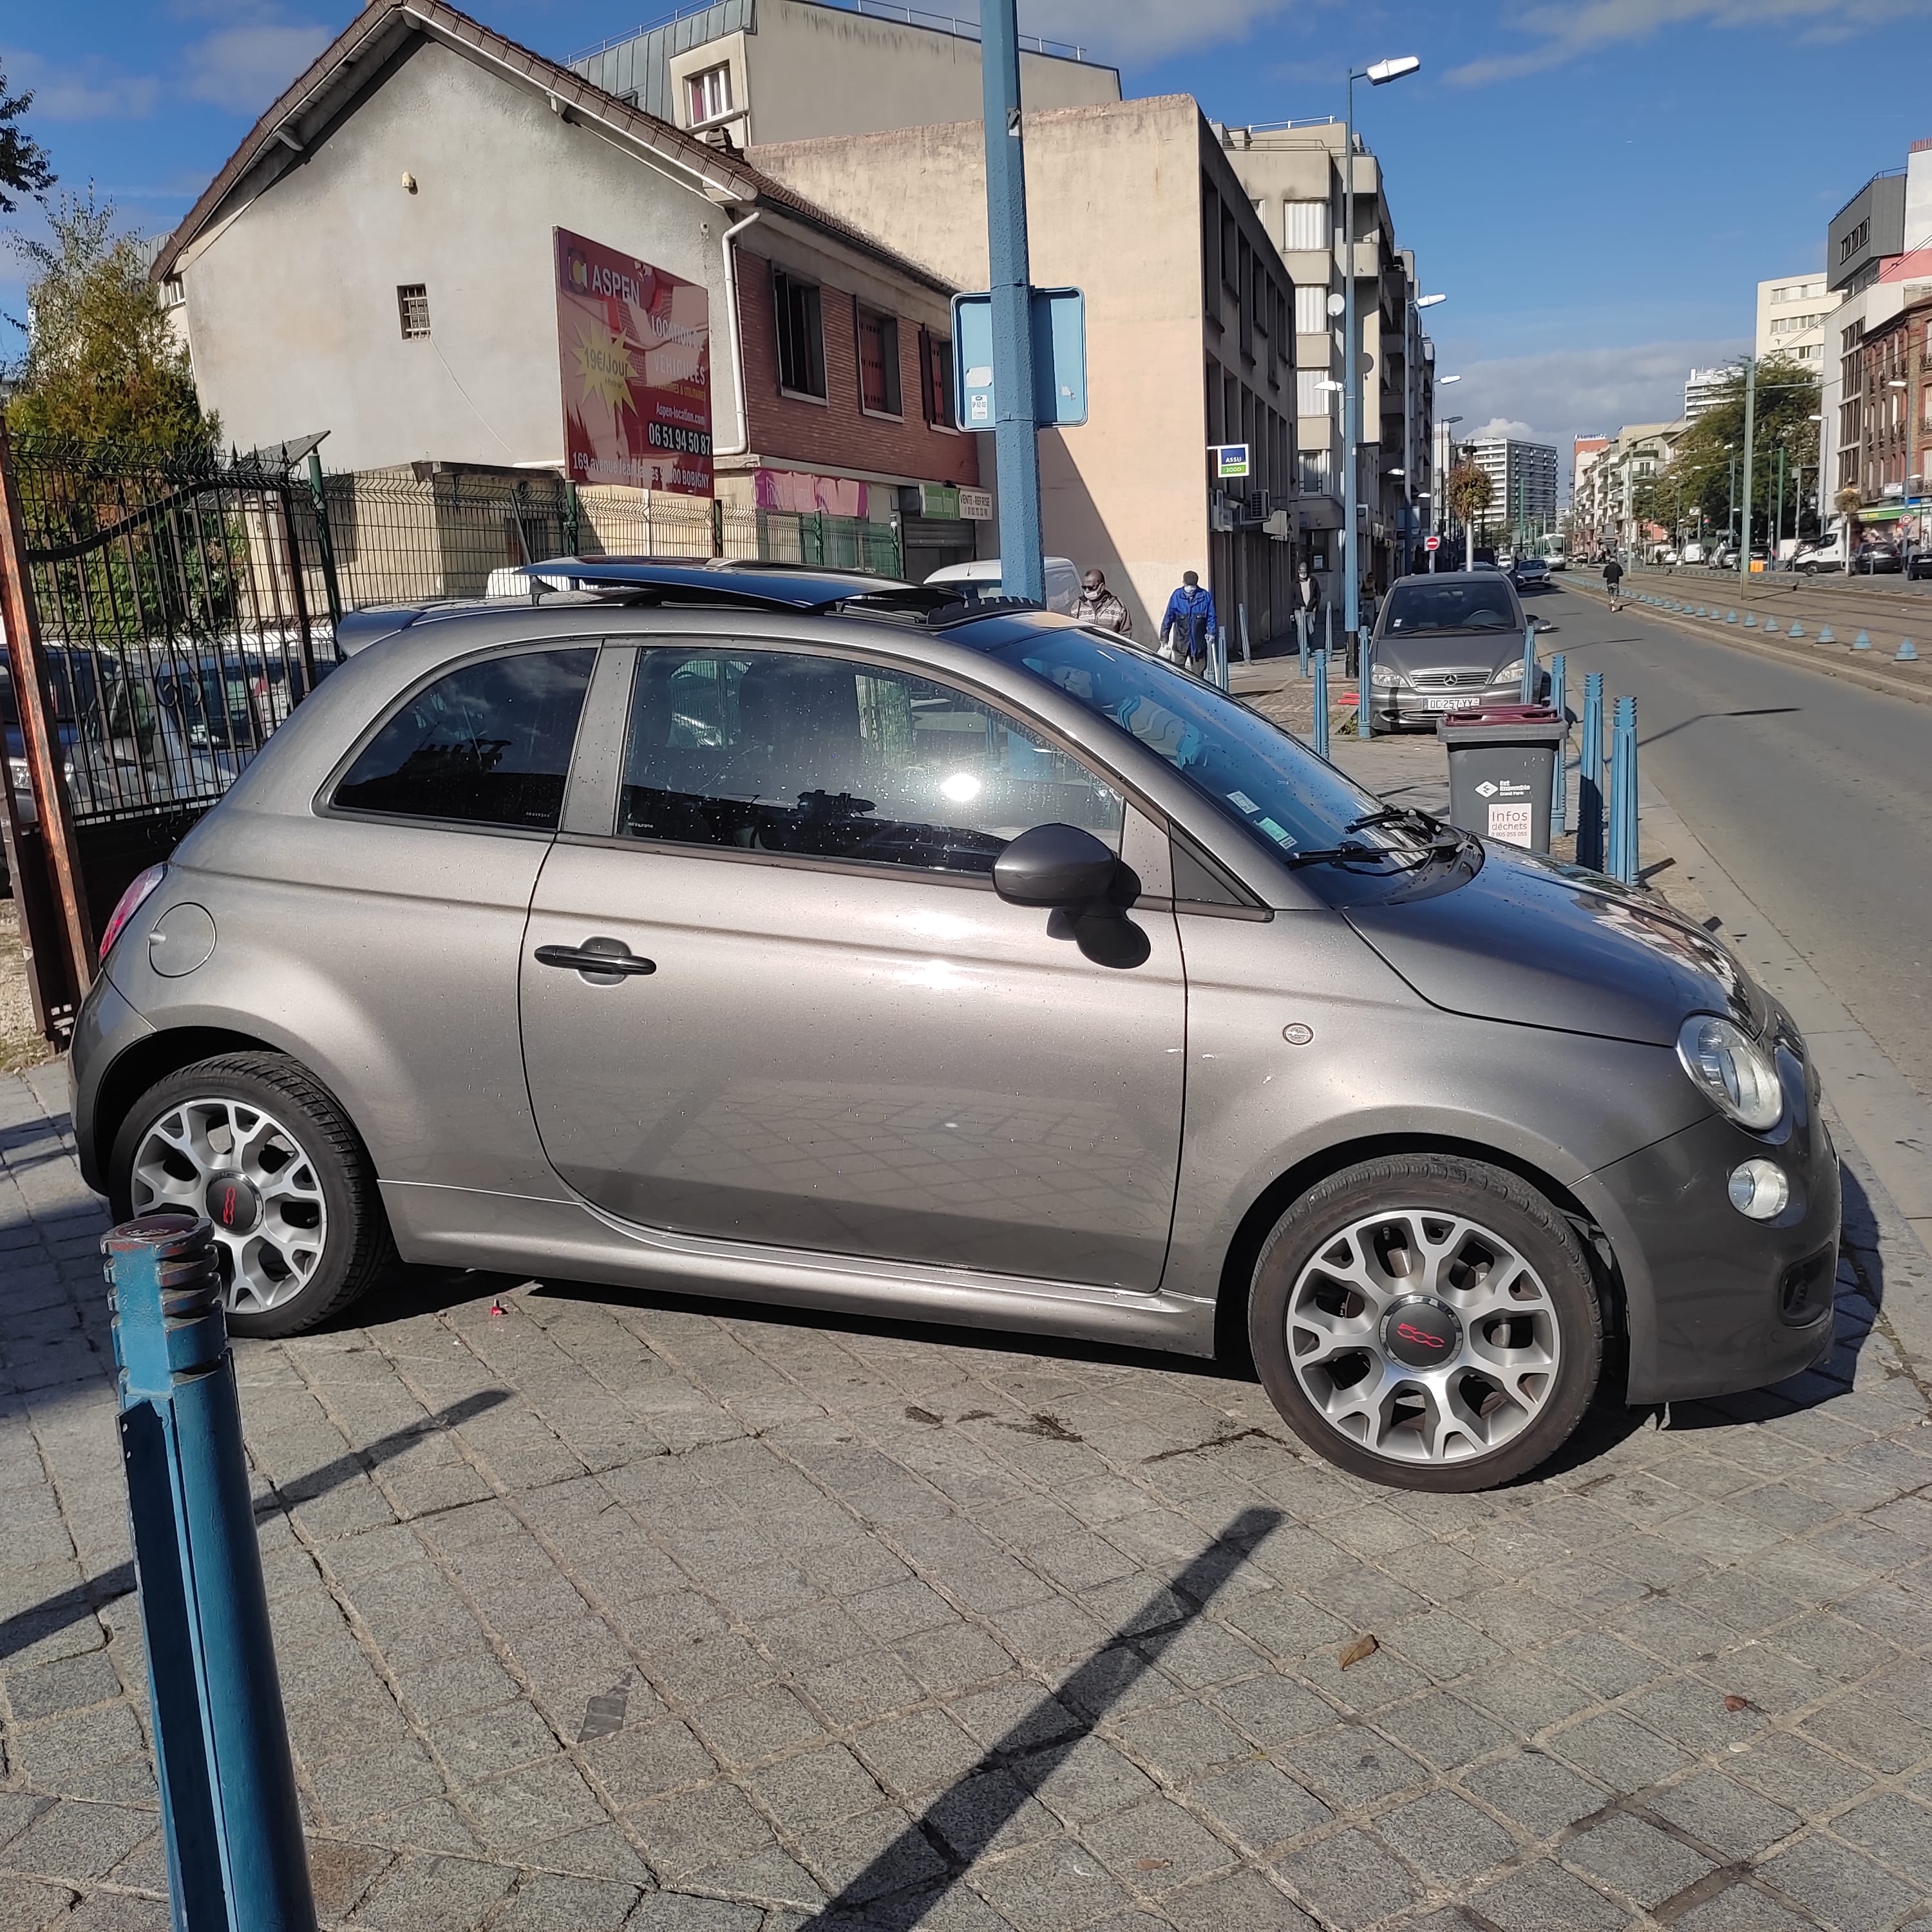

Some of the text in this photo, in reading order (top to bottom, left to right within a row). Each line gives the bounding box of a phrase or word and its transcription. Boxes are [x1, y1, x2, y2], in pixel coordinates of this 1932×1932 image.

[592, 264, 639, 308] ASPEN
[652, 315, 693, 348] LOCATION
[585, 347, 629, 377] 19€/Jour
[654, 351, 706, 386] VEHICULES
[656, 402, 705, 426] Aspen-location.com
[649, 422, 710, 456] 06 51 94 50 87
[591, 458, 618, 475] avenue
[636, 464, 659, 481] Jaes
[660, 468, 681, 484] 900
[683, 469, 710, 490] BOBIGNY
[1492, 811, 1528, 822] Infos
[1396, 1322, 1446, 1349] 500
